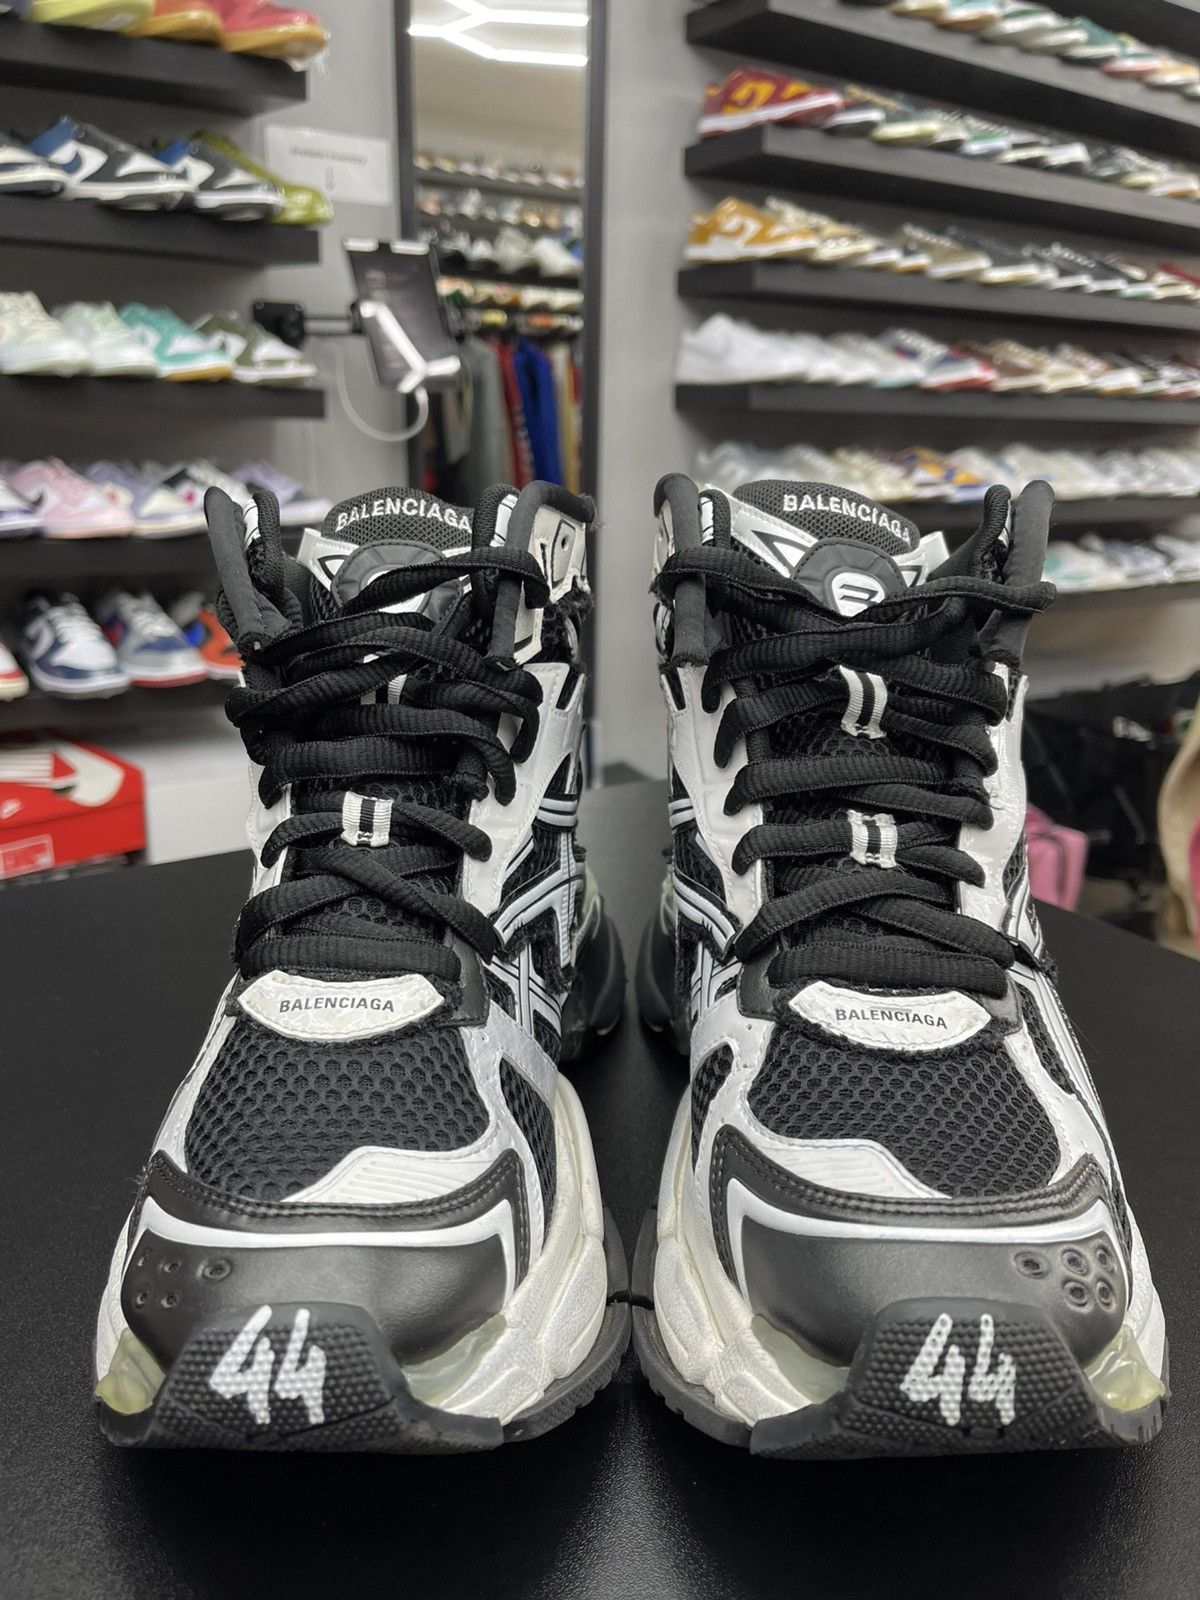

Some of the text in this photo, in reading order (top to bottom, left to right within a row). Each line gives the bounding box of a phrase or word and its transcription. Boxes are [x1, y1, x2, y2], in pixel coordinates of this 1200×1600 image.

[335, 497, 473, 534] BALENCIAGA
[783, 493, 911, 548] BALENCIAGA
[280, 997, 394, 1013] BALENCIAGA
[835, 1008, 948, 1029] BALENCIAGA
[209, 1304, 327, 1425] 44
[900, 1312, 1016, 1426] 44
